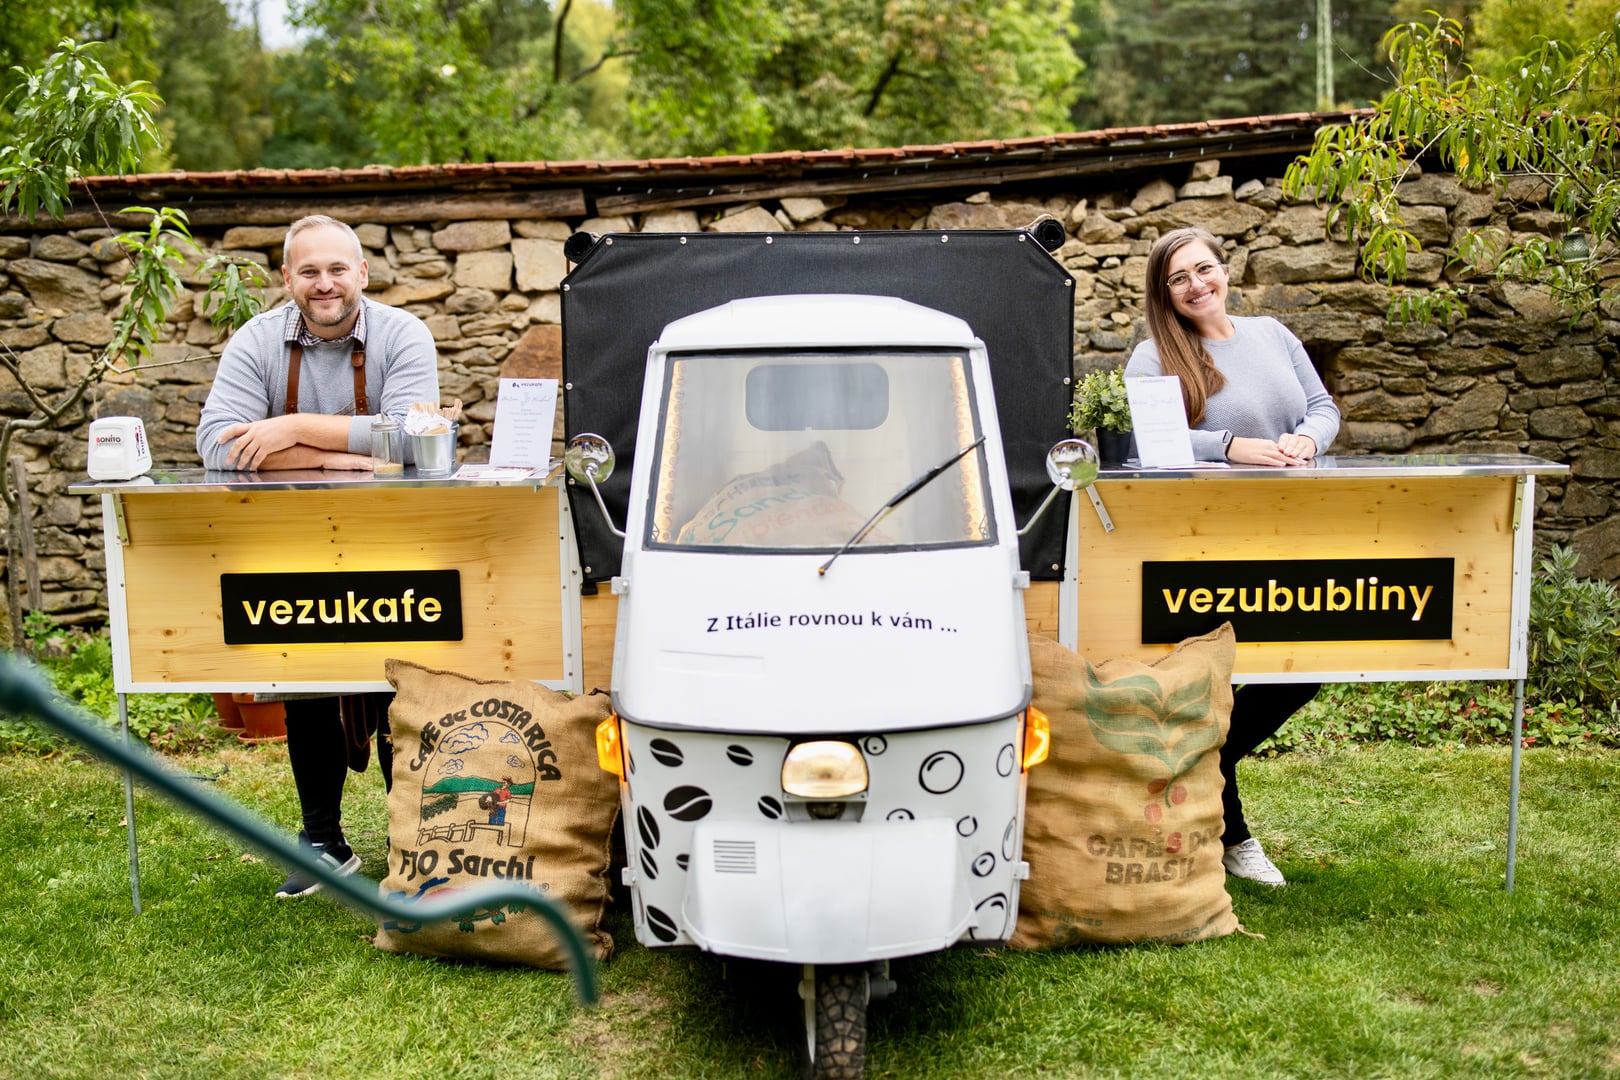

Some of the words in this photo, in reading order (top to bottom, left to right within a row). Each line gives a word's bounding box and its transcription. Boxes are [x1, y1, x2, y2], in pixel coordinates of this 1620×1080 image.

[241, 588, 443, 625] vezukafe
[1162, 576, 1434, 621] vezububliny
[726, 612, 782, 631] Itálie
[789, 613, 863, 627] rovnou
[871, 611, 882, 627] k
[890, 612, 933, 630] vám
[439, 709, 467, 728] de
[470, 698, 533, 731] COSTA
[523, 722, 562, 781] RICA
[399, 849, 439, 882] FJO
[447, 848, 536, 882] Sarchi
[1105, 857, 1195, 884] BRASIL
